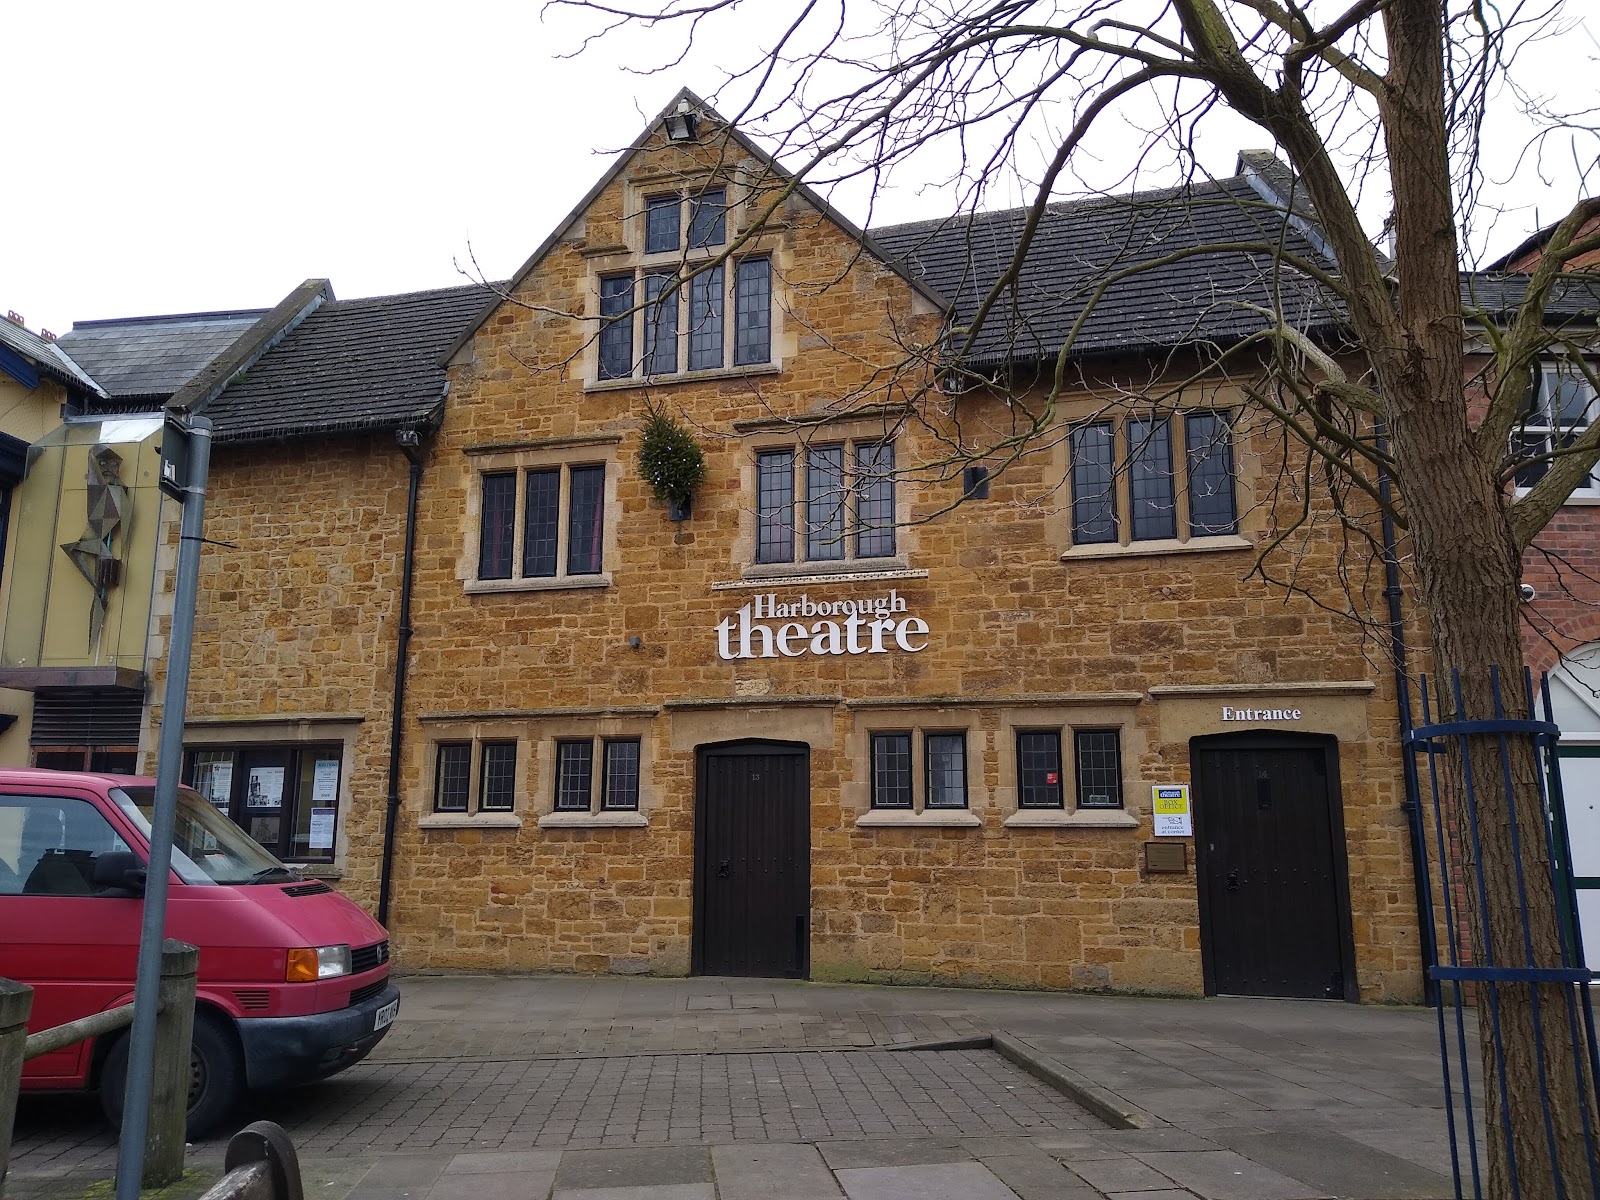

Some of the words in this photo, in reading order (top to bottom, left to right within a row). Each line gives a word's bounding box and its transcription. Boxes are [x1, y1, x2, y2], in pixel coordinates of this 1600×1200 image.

[752, 588, 908, 620] Harborough
[714, 602, 930, 660] theatre
[1221, 706, 1302, 721] Entrance
